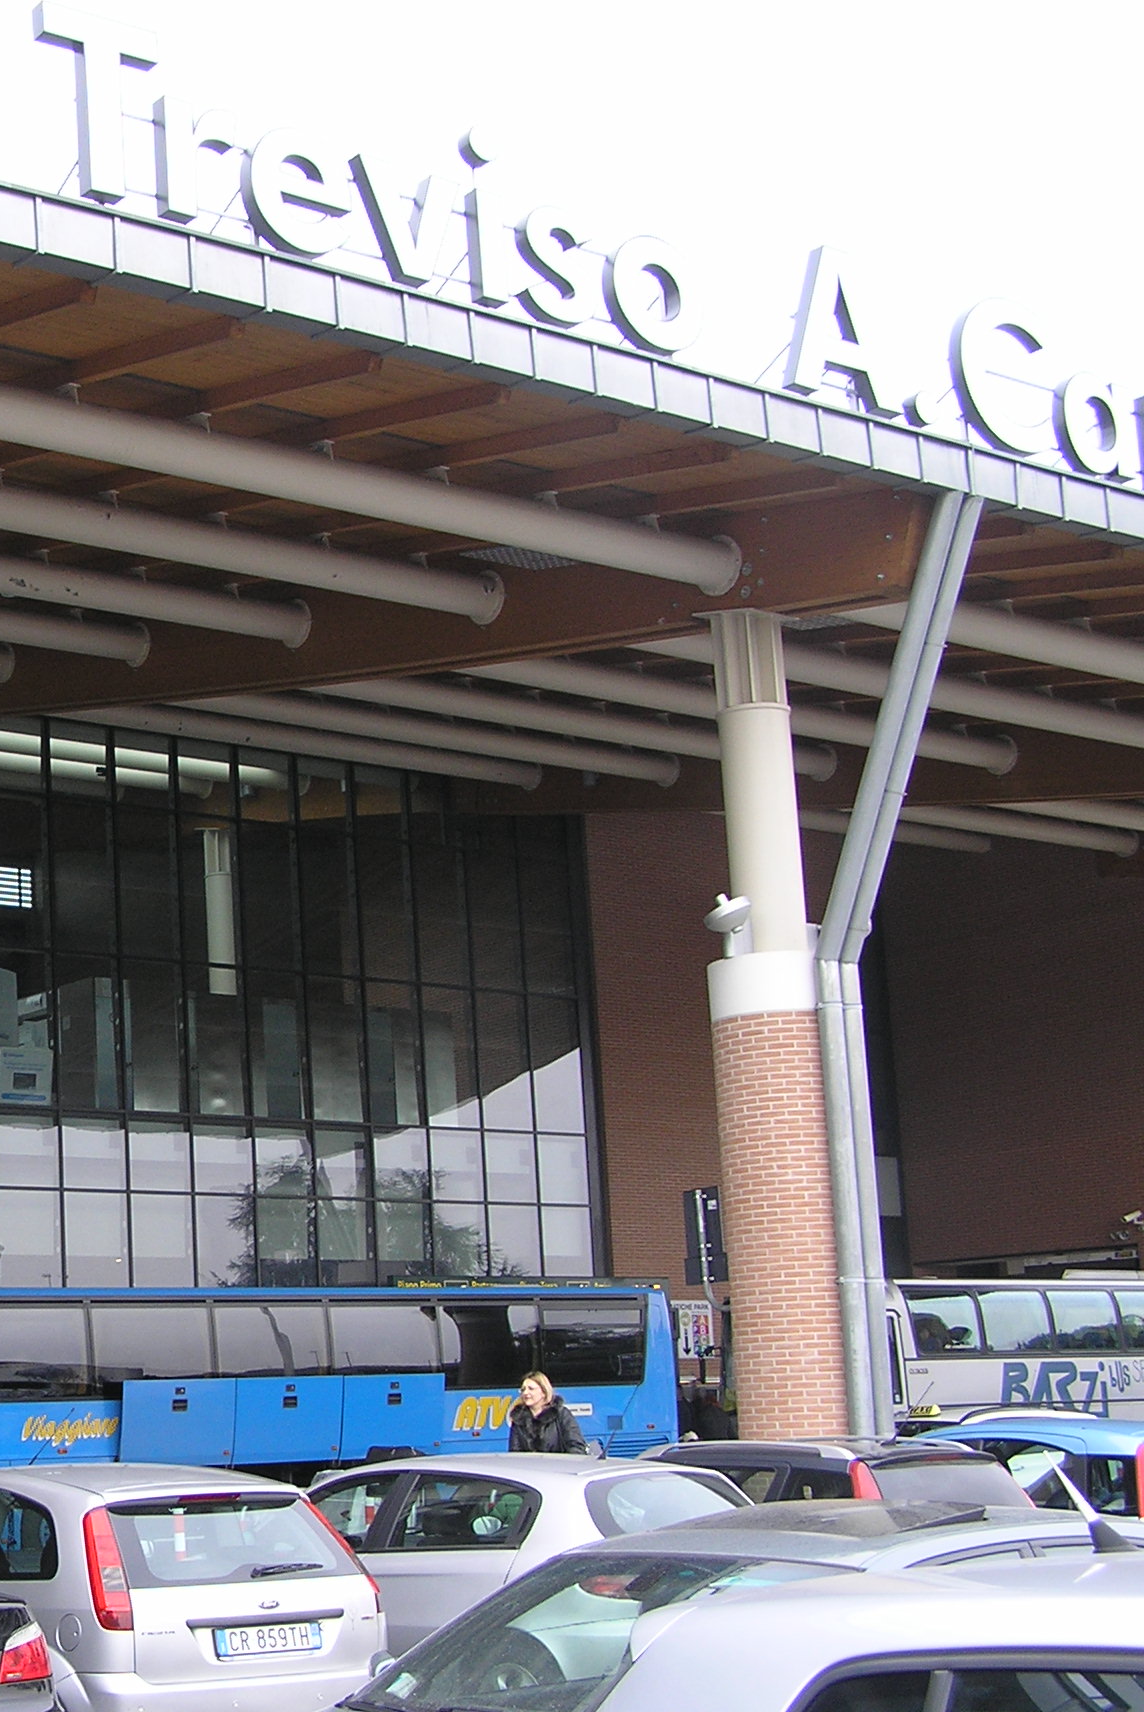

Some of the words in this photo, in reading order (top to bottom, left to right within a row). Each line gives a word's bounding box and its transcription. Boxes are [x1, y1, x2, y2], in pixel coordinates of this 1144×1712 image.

[32, 1, 705, 357] Treviso
[229, 1630, 250, 1652] CR
[257, 1625, 310, 1648] 859TH
